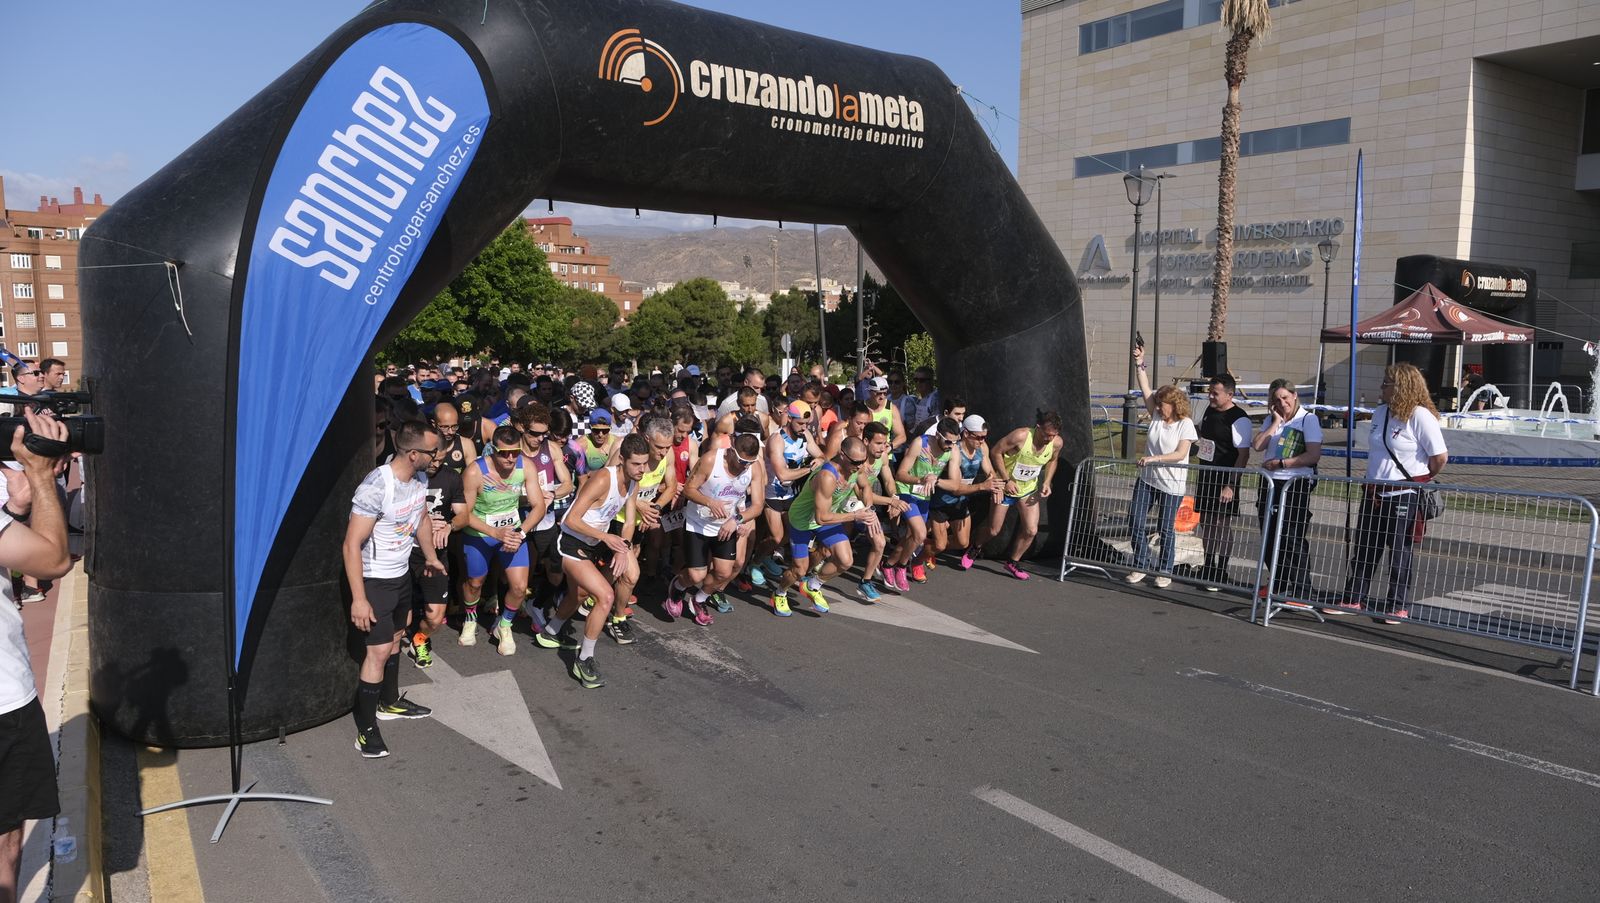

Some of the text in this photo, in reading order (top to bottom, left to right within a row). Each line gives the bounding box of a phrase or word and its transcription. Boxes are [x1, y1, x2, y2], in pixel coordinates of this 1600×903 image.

[690, 59, 925, 132] cruzandolameta
[771, 115, 924, 149] cronometraje deportivo
[364, 124, 481, 306] centrohogarsanchez.es
[1217, 217, 1344, 241] IVERSITARIO
[1156, 247, 1313, 271] TORRERDENAS
[639, 488, 655, 498] 109
[493, 517, 514, 528] 159
[667, 511, 684, 523] 118
